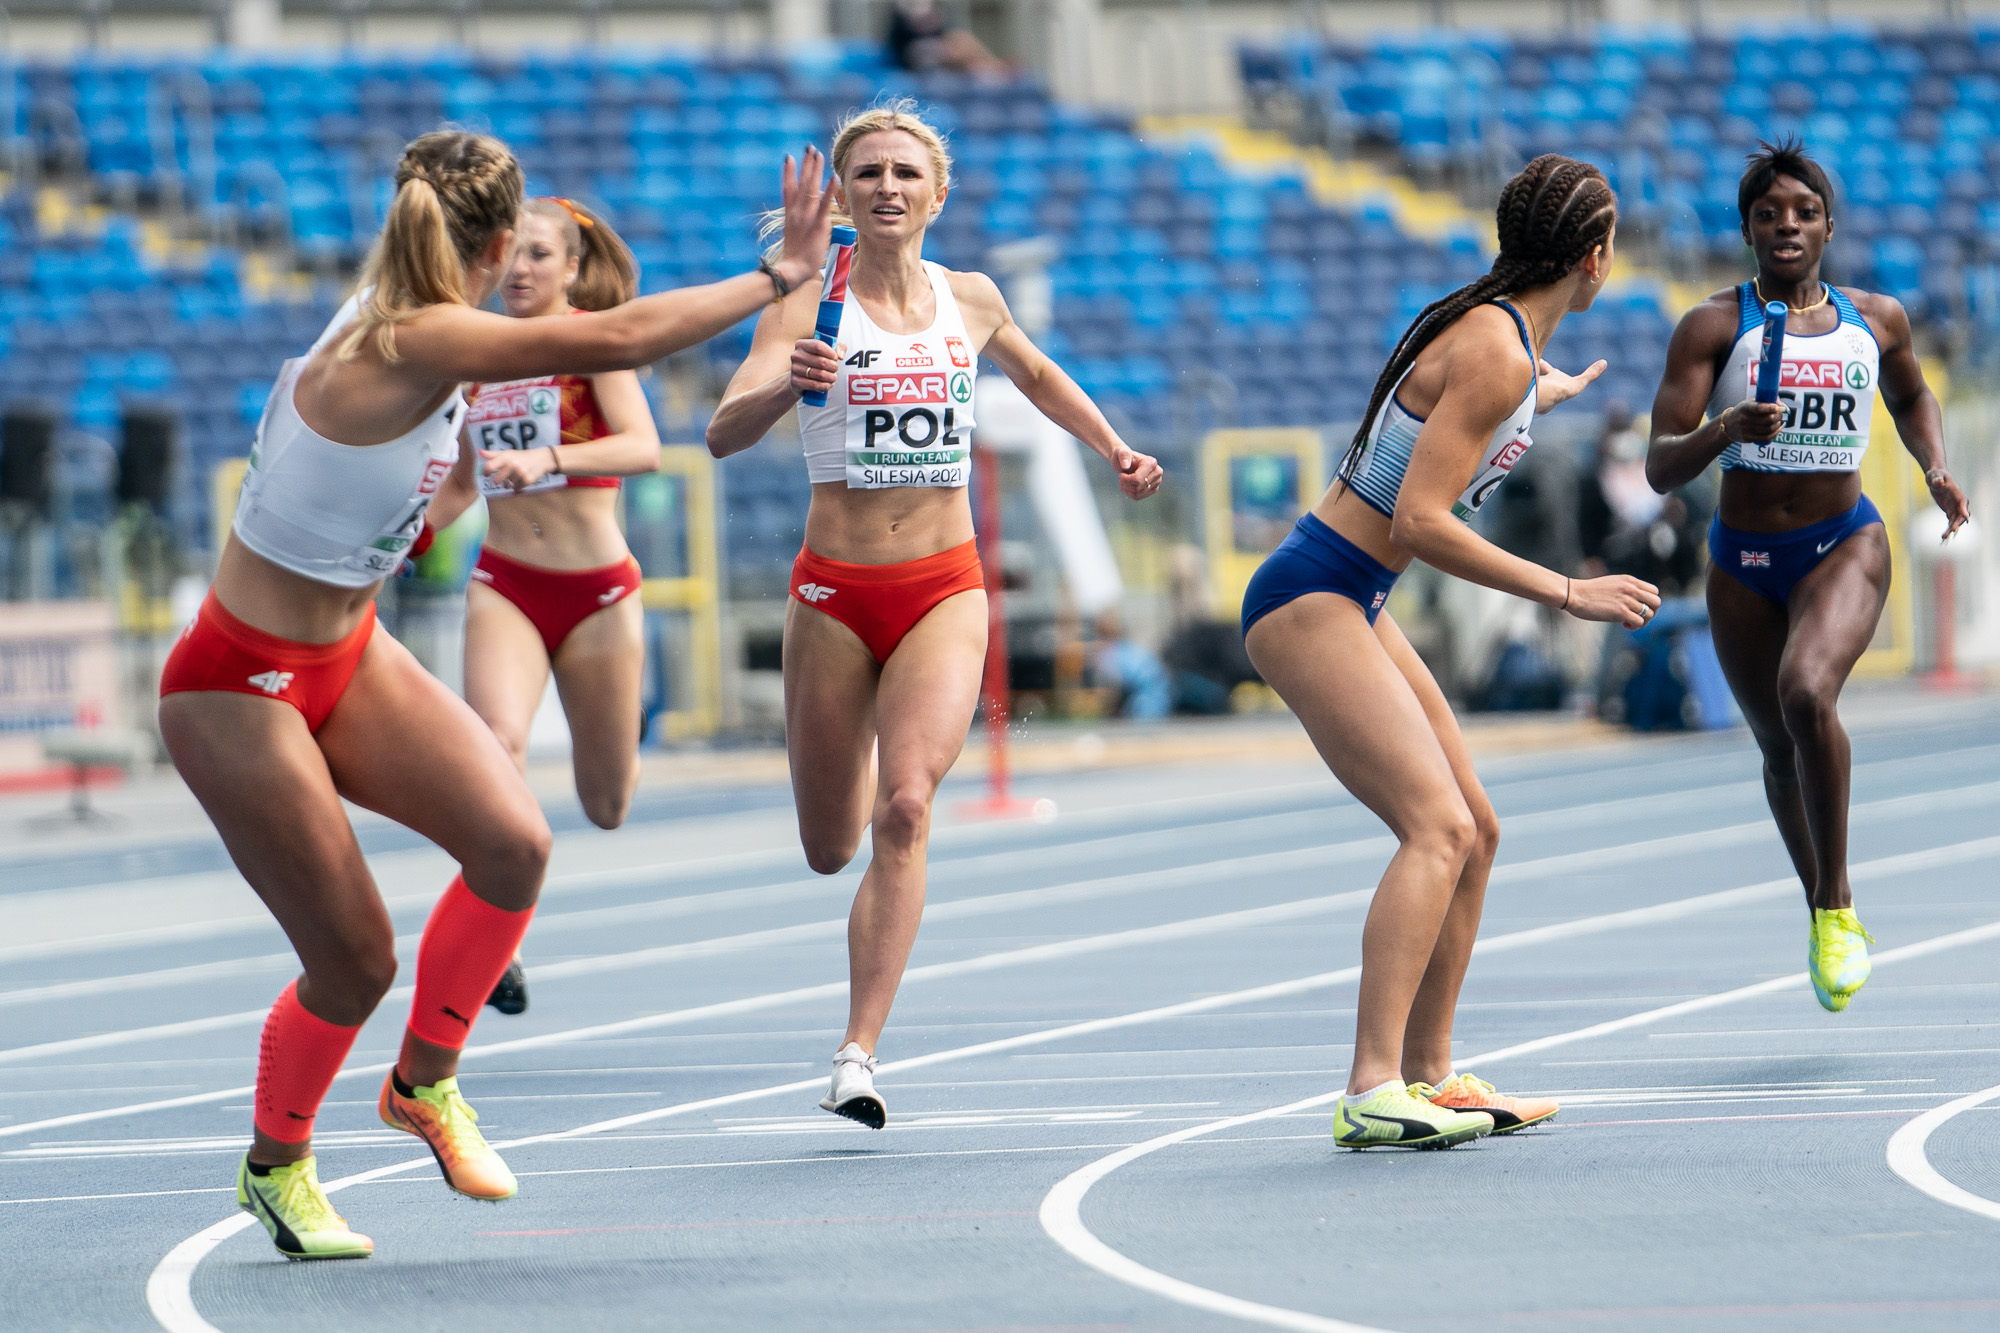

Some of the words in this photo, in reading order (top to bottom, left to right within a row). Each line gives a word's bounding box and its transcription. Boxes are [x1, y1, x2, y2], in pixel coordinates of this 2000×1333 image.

[845, 350, 882, 368] 4F
[897, 358, 932, 367] ORLEN
[851, 376, 945, 401] SPAR
[1778, 390, 1857, 431] GBR
[865, 407, 960, 448] POL
[1776, 433, 1800, 443] RUN
[1803, 434, 1842, 445] CLEAN
[882, 454, 909, 464] RUN
[913, 453, 950, 463] CLEAN
[1757, 446, 1815, 463] SILESIA
[1820, 451, 1853, 465] 2021
[864, 469, 925, 484] SILESIA
[930, 468, 962, 483] 2021
[798, 583, 837, 603] 4F
[247, 670, 295, 695] 4F
